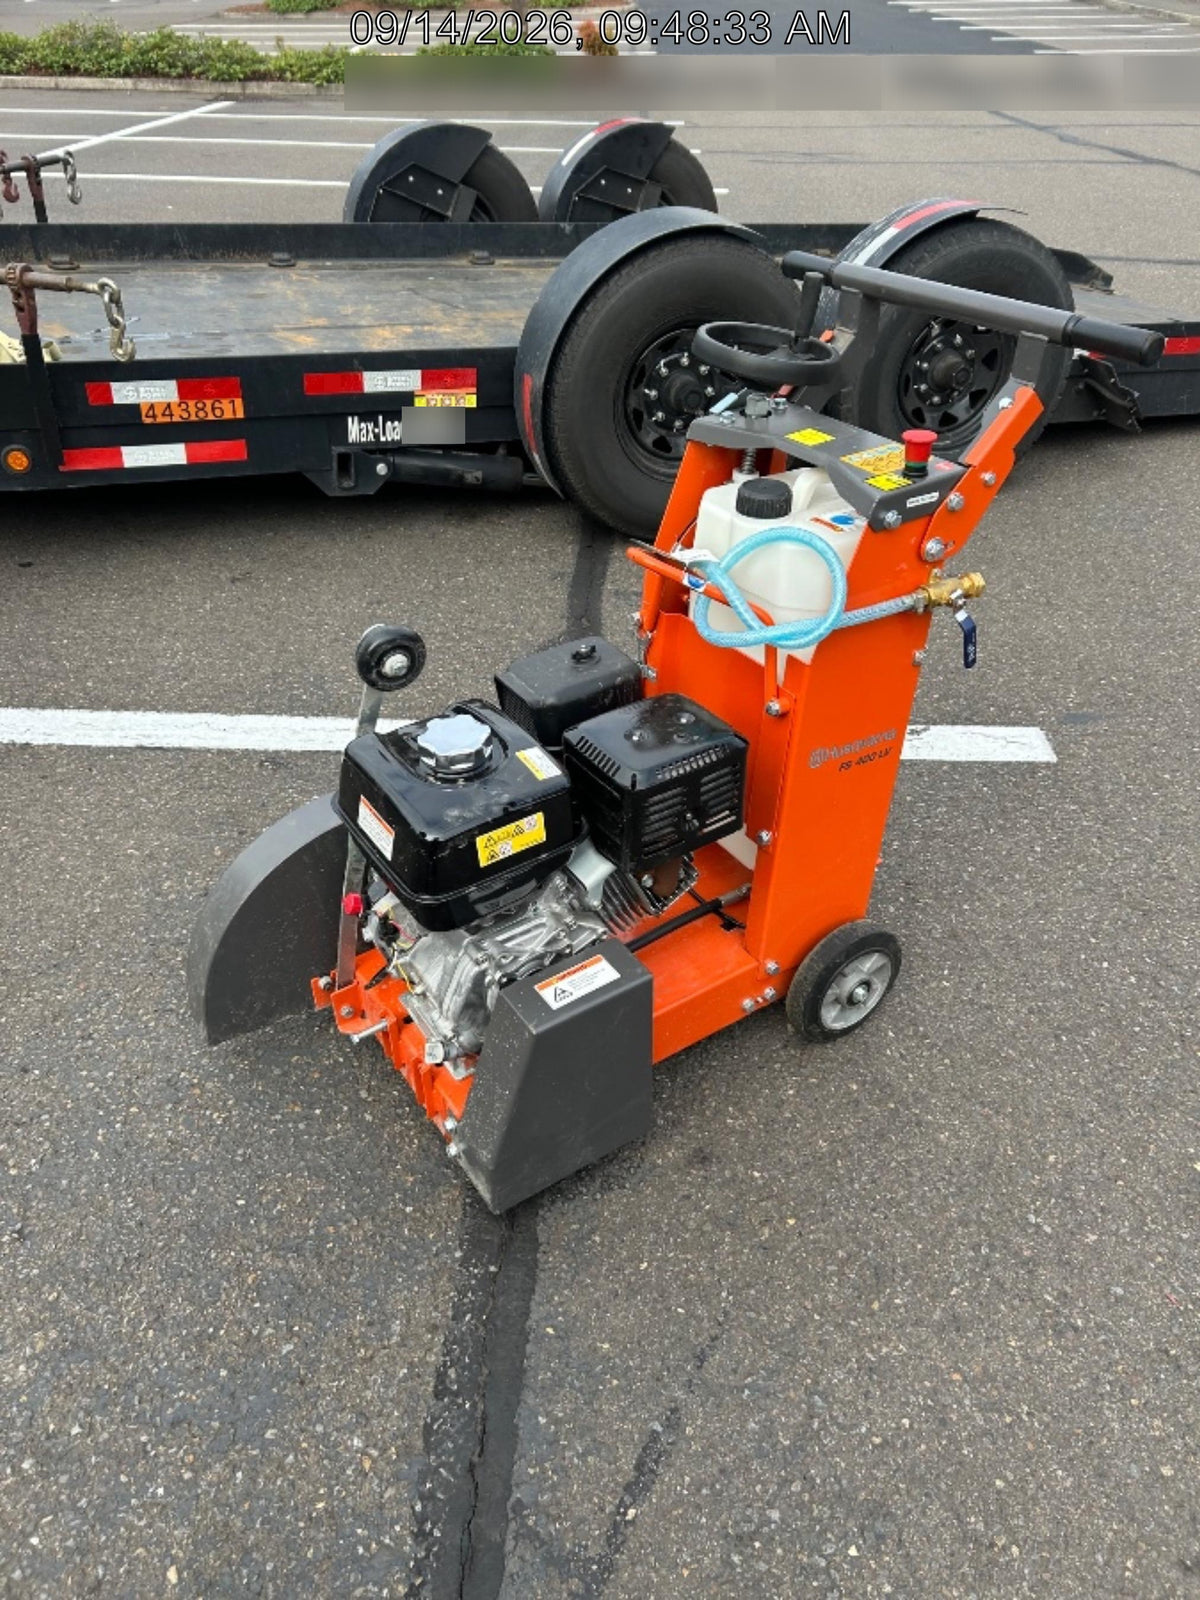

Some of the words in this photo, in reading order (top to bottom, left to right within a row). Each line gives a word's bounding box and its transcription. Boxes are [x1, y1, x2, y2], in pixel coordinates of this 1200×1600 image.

[144, 400, 238, 422] 443861
[347, 415, 403, 444] Max-Loa
[838, 760, 853, 772] FS
[854, 752, 877, 766] 400
[878, 746, 893, 759] LV
